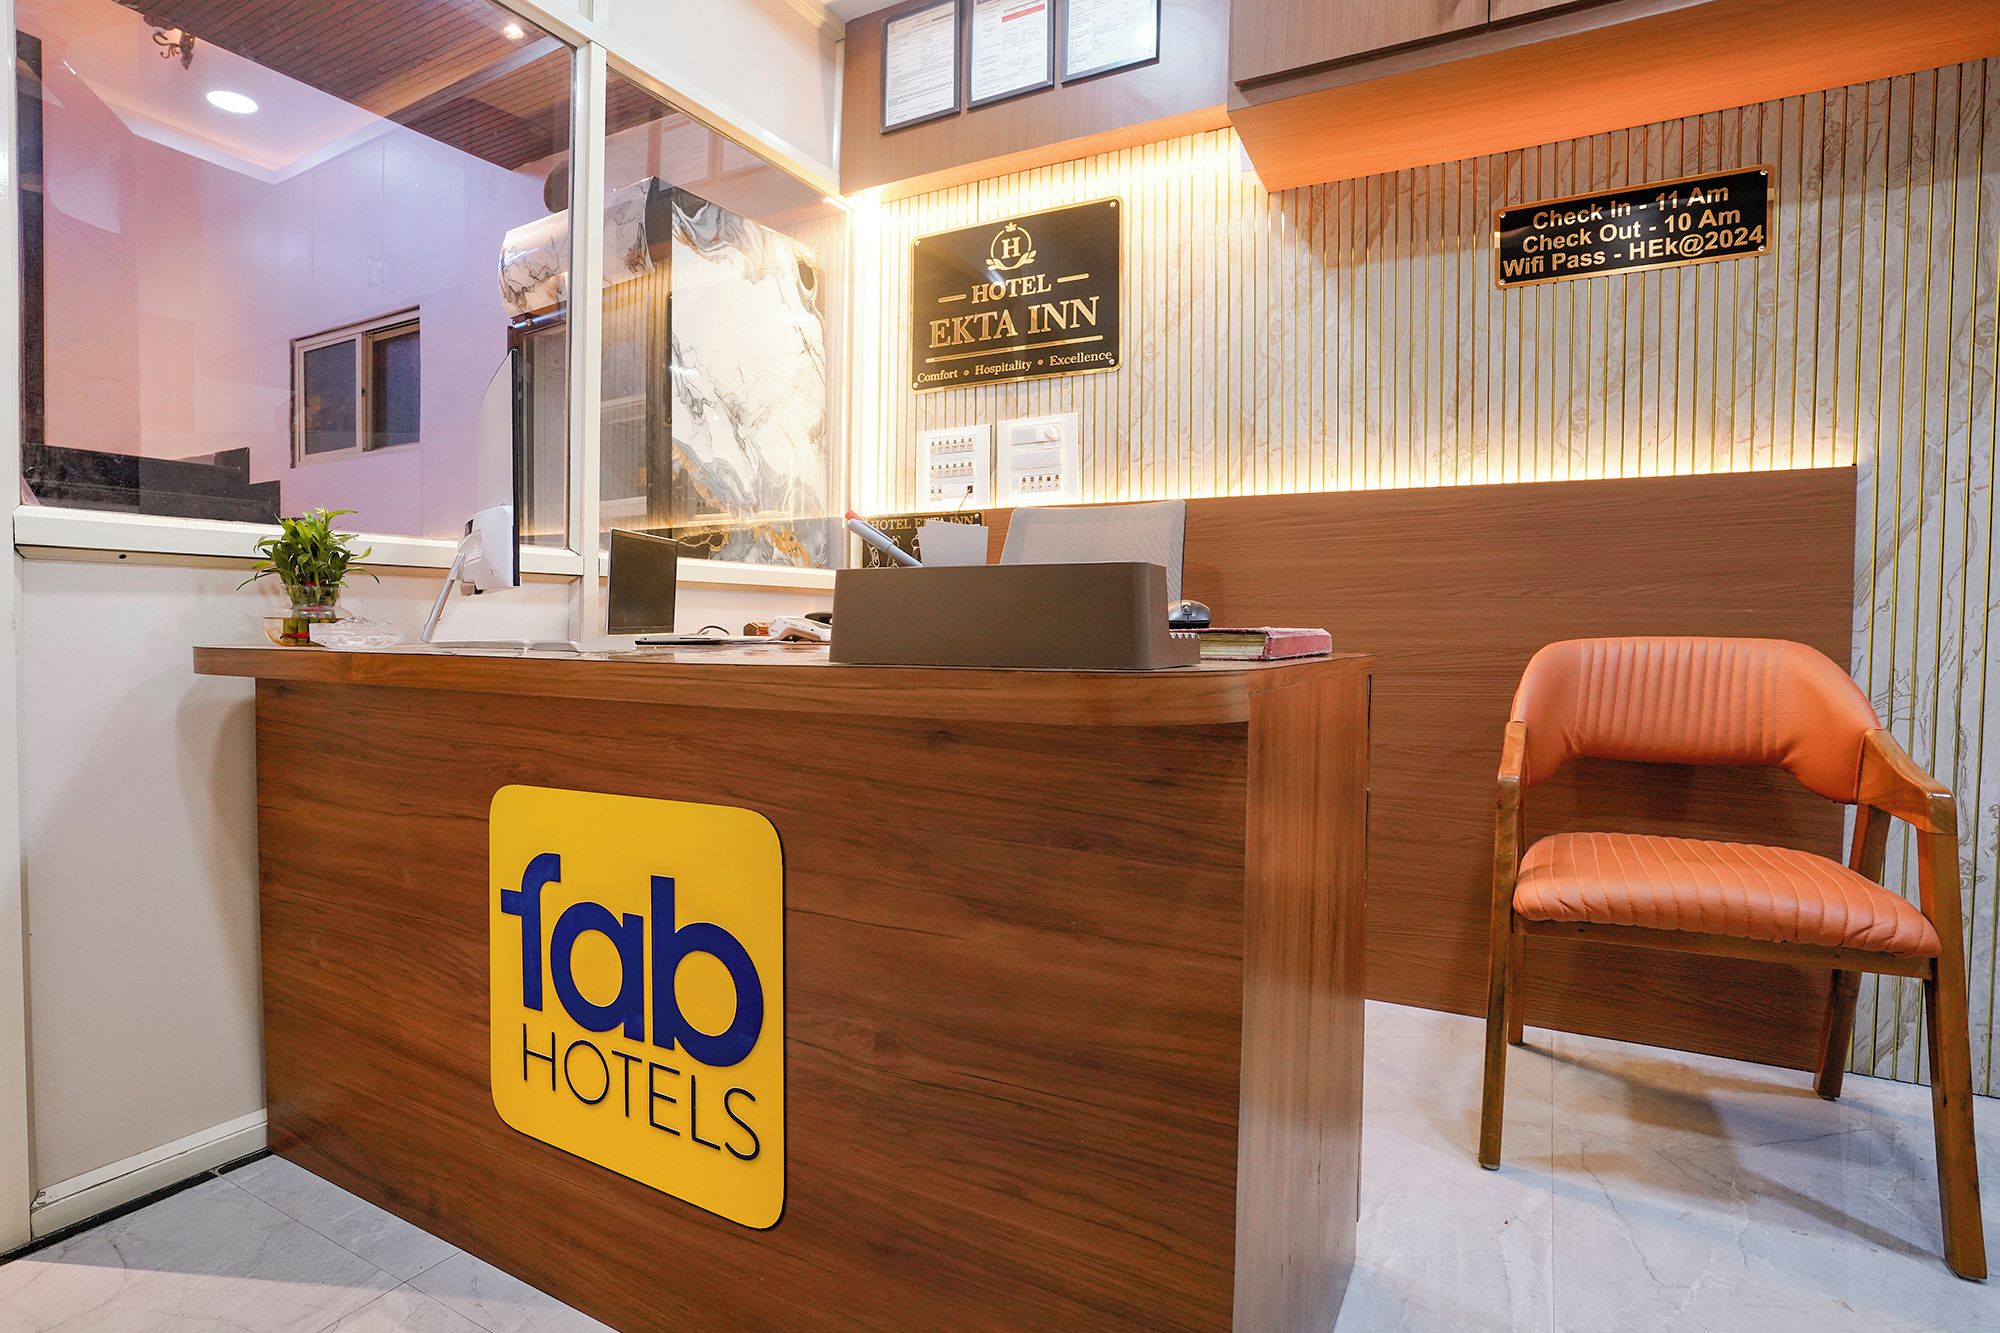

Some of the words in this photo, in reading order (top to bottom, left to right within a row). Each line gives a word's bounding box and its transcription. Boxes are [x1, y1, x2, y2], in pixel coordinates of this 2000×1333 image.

[1532, 204, 1604, 230] Check
[1610, 200, 1631, 218] In
[1656, 190, 1679, 211] 11
[1686, 185, 1729, 206] Am
[1001, 236, 1021, 260] H
[1503, 255, 1544, 277] Wifi
[1552, 250, 1606, 271] Pass
[1629, 224, 1764, 261] HEk@2024
[1522, 228, 1593, 254] Check
[1599, 220, 1642, 243] Out
[1664, 212, 1692, 233] 10
[1698, 208, 1741, 229] Am
[971, 273, 1052, 304] HOTEL
[928, 309, 1018, 349] EKTA
[1027, 296, 1100, 335] INN
[917, 369, 958, 384] Comfort
[974, 360, 1033, 377] Hospitality
[1049, 350, 1113, 367] Excellence
[871, 518, 912, 531] HOTEL
[500, 852, 764, 1067] fab
[522, 1022, 761, 1161] HOTELS
